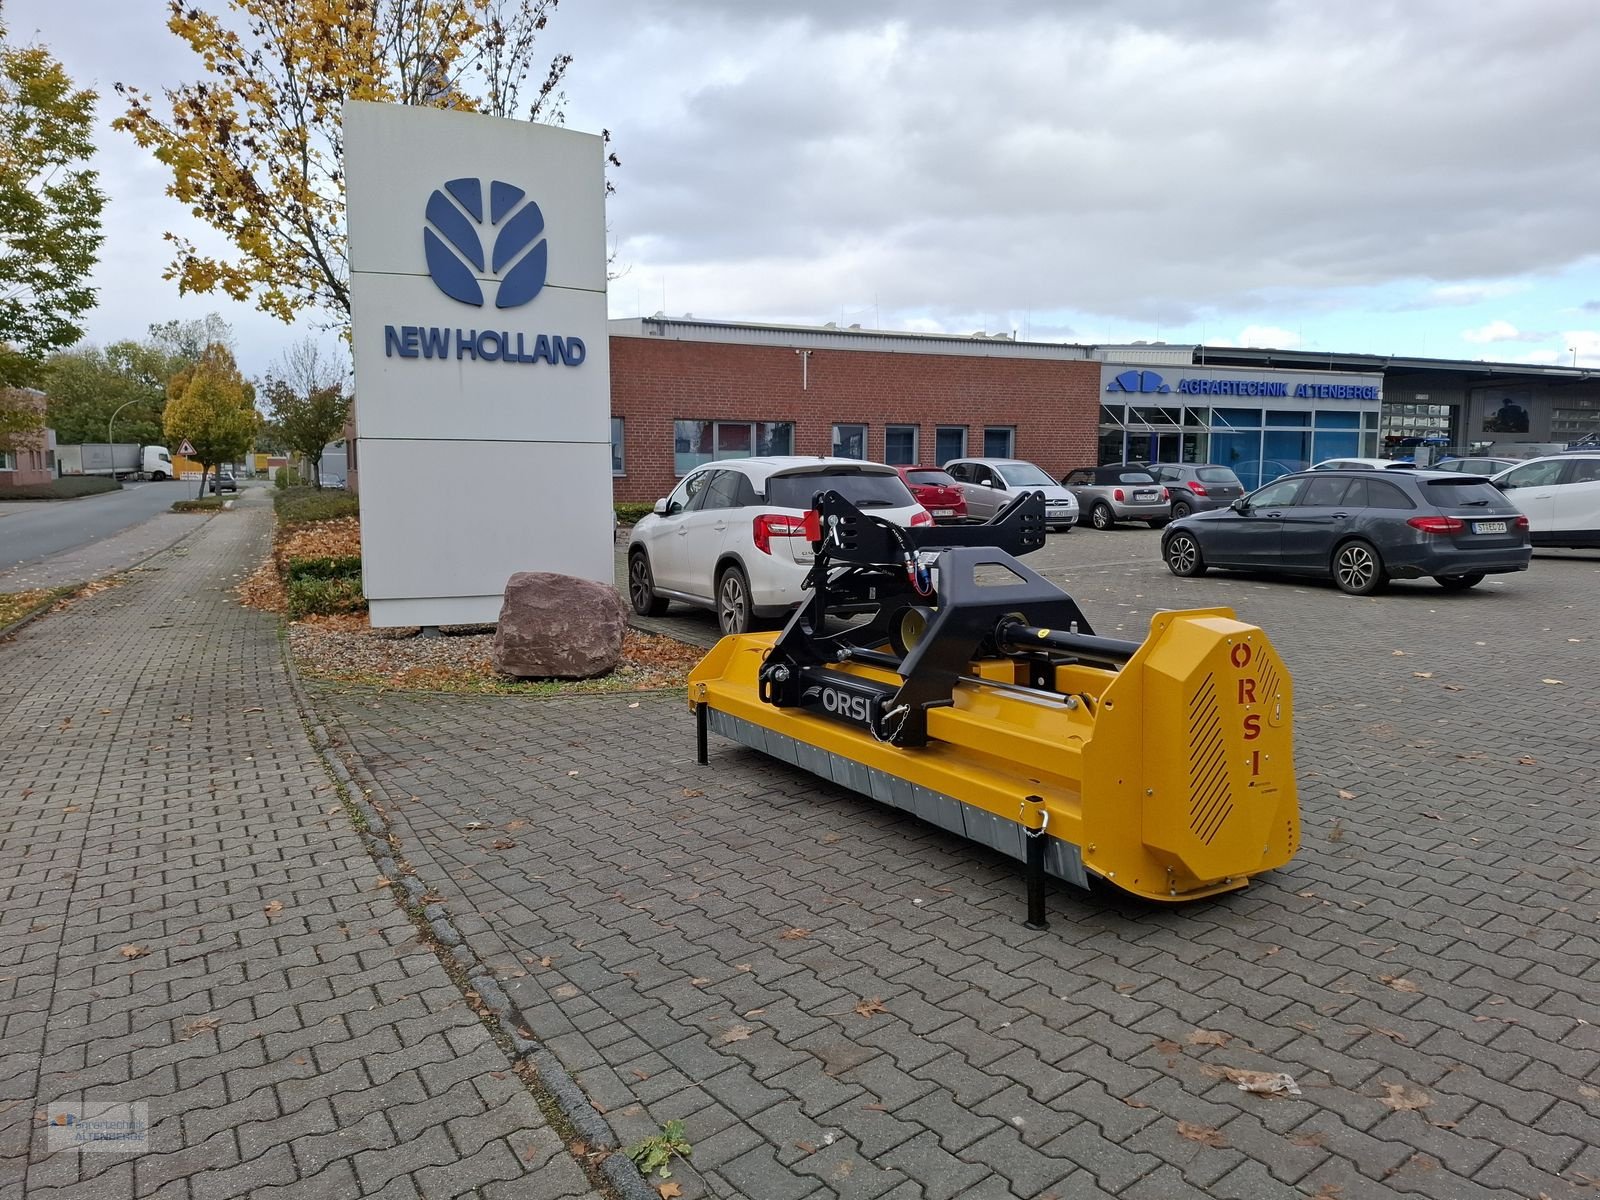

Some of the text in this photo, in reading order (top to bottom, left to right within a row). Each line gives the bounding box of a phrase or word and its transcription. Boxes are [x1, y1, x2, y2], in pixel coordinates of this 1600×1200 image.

[384, 325, 586, 366] NEW HOLLAND
[1178, 379, 1379, 400] AGRARTECHNIK ALTENBERGE
[822, 687, 872, 723] ORSI
[1230, 642, 1262, 776] ORSI
